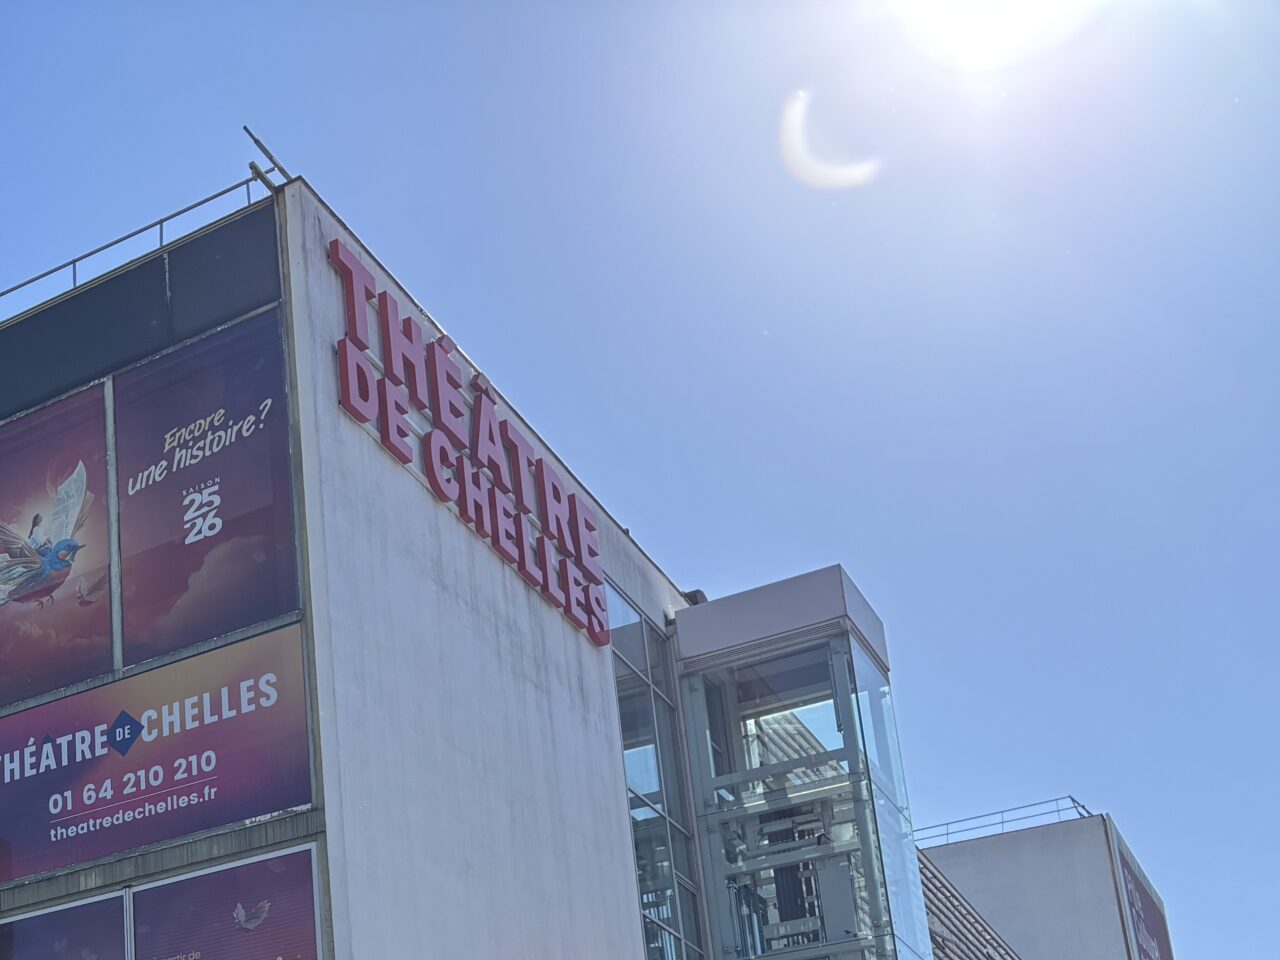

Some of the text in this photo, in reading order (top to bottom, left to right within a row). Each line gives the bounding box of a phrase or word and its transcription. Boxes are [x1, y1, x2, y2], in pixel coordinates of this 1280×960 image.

[163, 408, 225, 453] Encore
[328, 238, 603, 586] THÉÂTRE
[127, 459, 168, 496] une
[182, 476, 220, 496] SAISON
[337, 336, 610, 647] DE CHELLES
[182, 484, 221, 522] 25
[183, 508, 223, 545] 26
[115, 724, 131, 741] DE
[140, 672, 278, 743] CHELLES
[48, 750, 217, 815] 01 64 210 210
[49, 785, 218, 842] theatredechelles.fr
[188, 951, 201, 960] de
